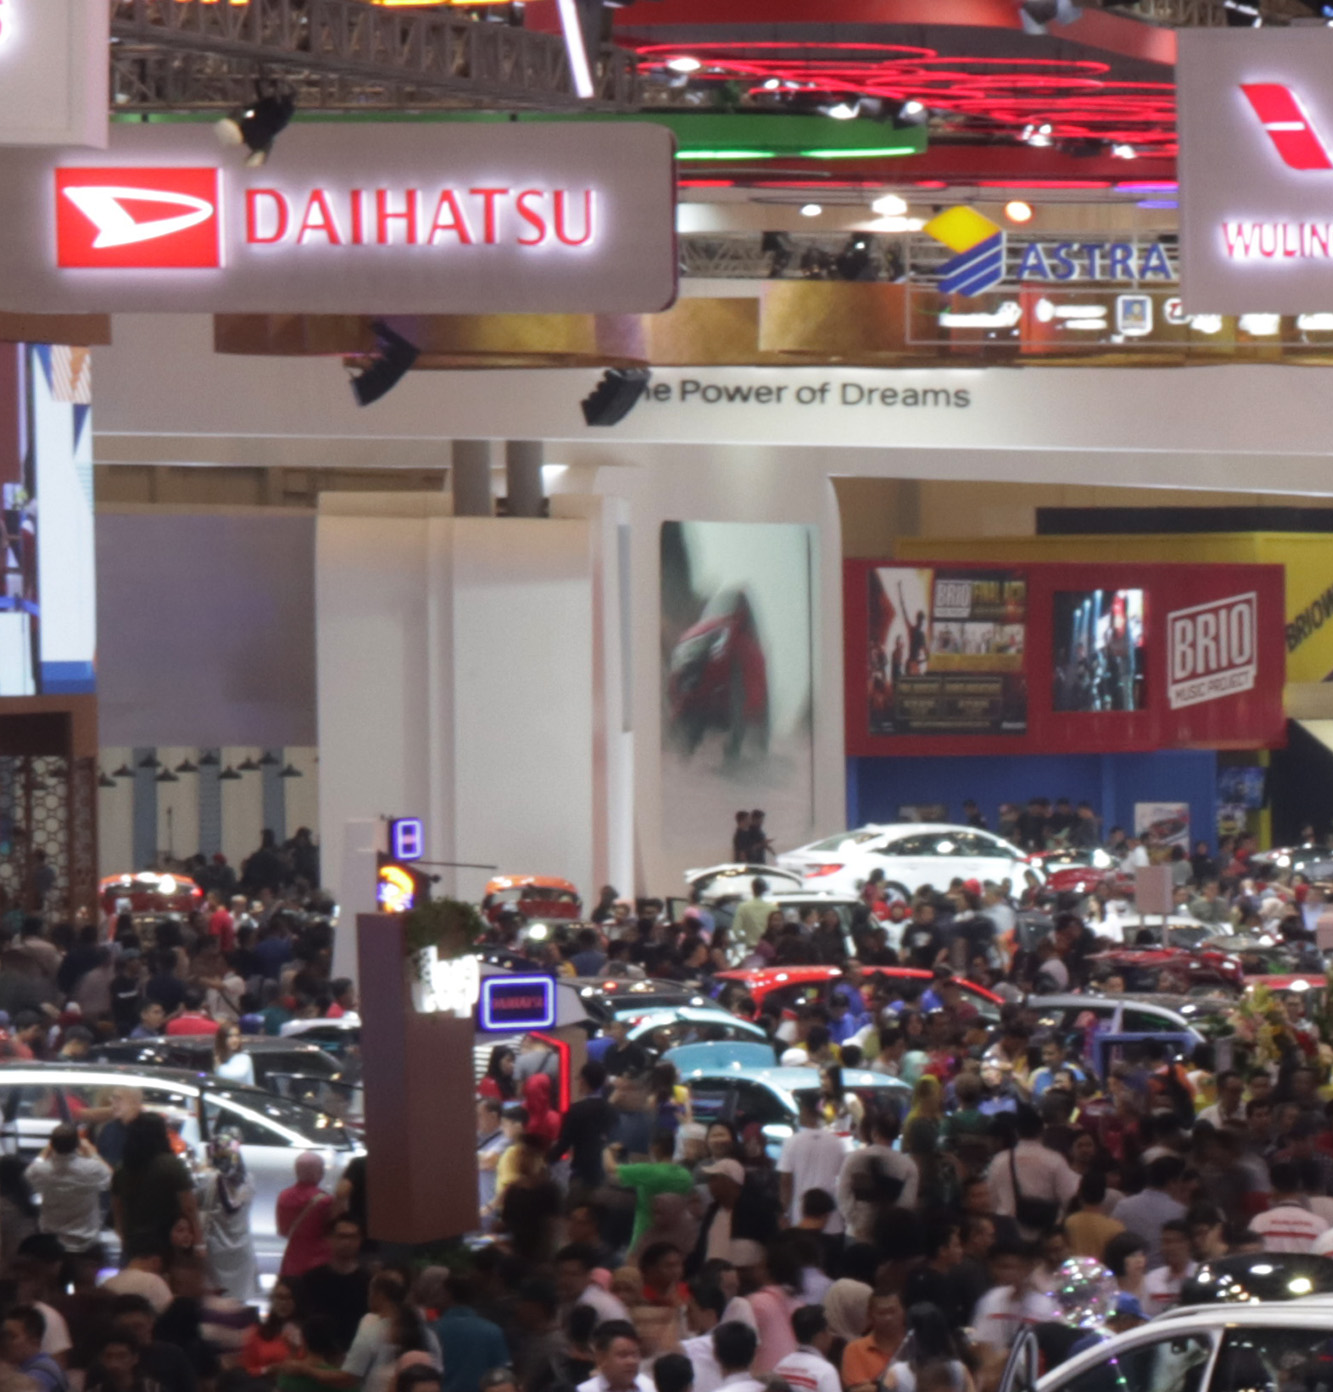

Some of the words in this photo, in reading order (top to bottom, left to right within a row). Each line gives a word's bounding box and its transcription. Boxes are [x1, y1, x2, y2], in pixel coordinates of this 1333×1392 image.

[244, 187, 597, 247] DAIHATSU
[1017, 242, 1173, 281] ASTRA
[680, 380, 786, 405] Power
[798, 382, 831, 405] of
[841, 382, 971, 409] Dreams
[1173, 602, 1252, 680] BRIO
[1174, 682, 1206, 702] MUSIC
[1207, 671, 1254, 697] PROJECT
